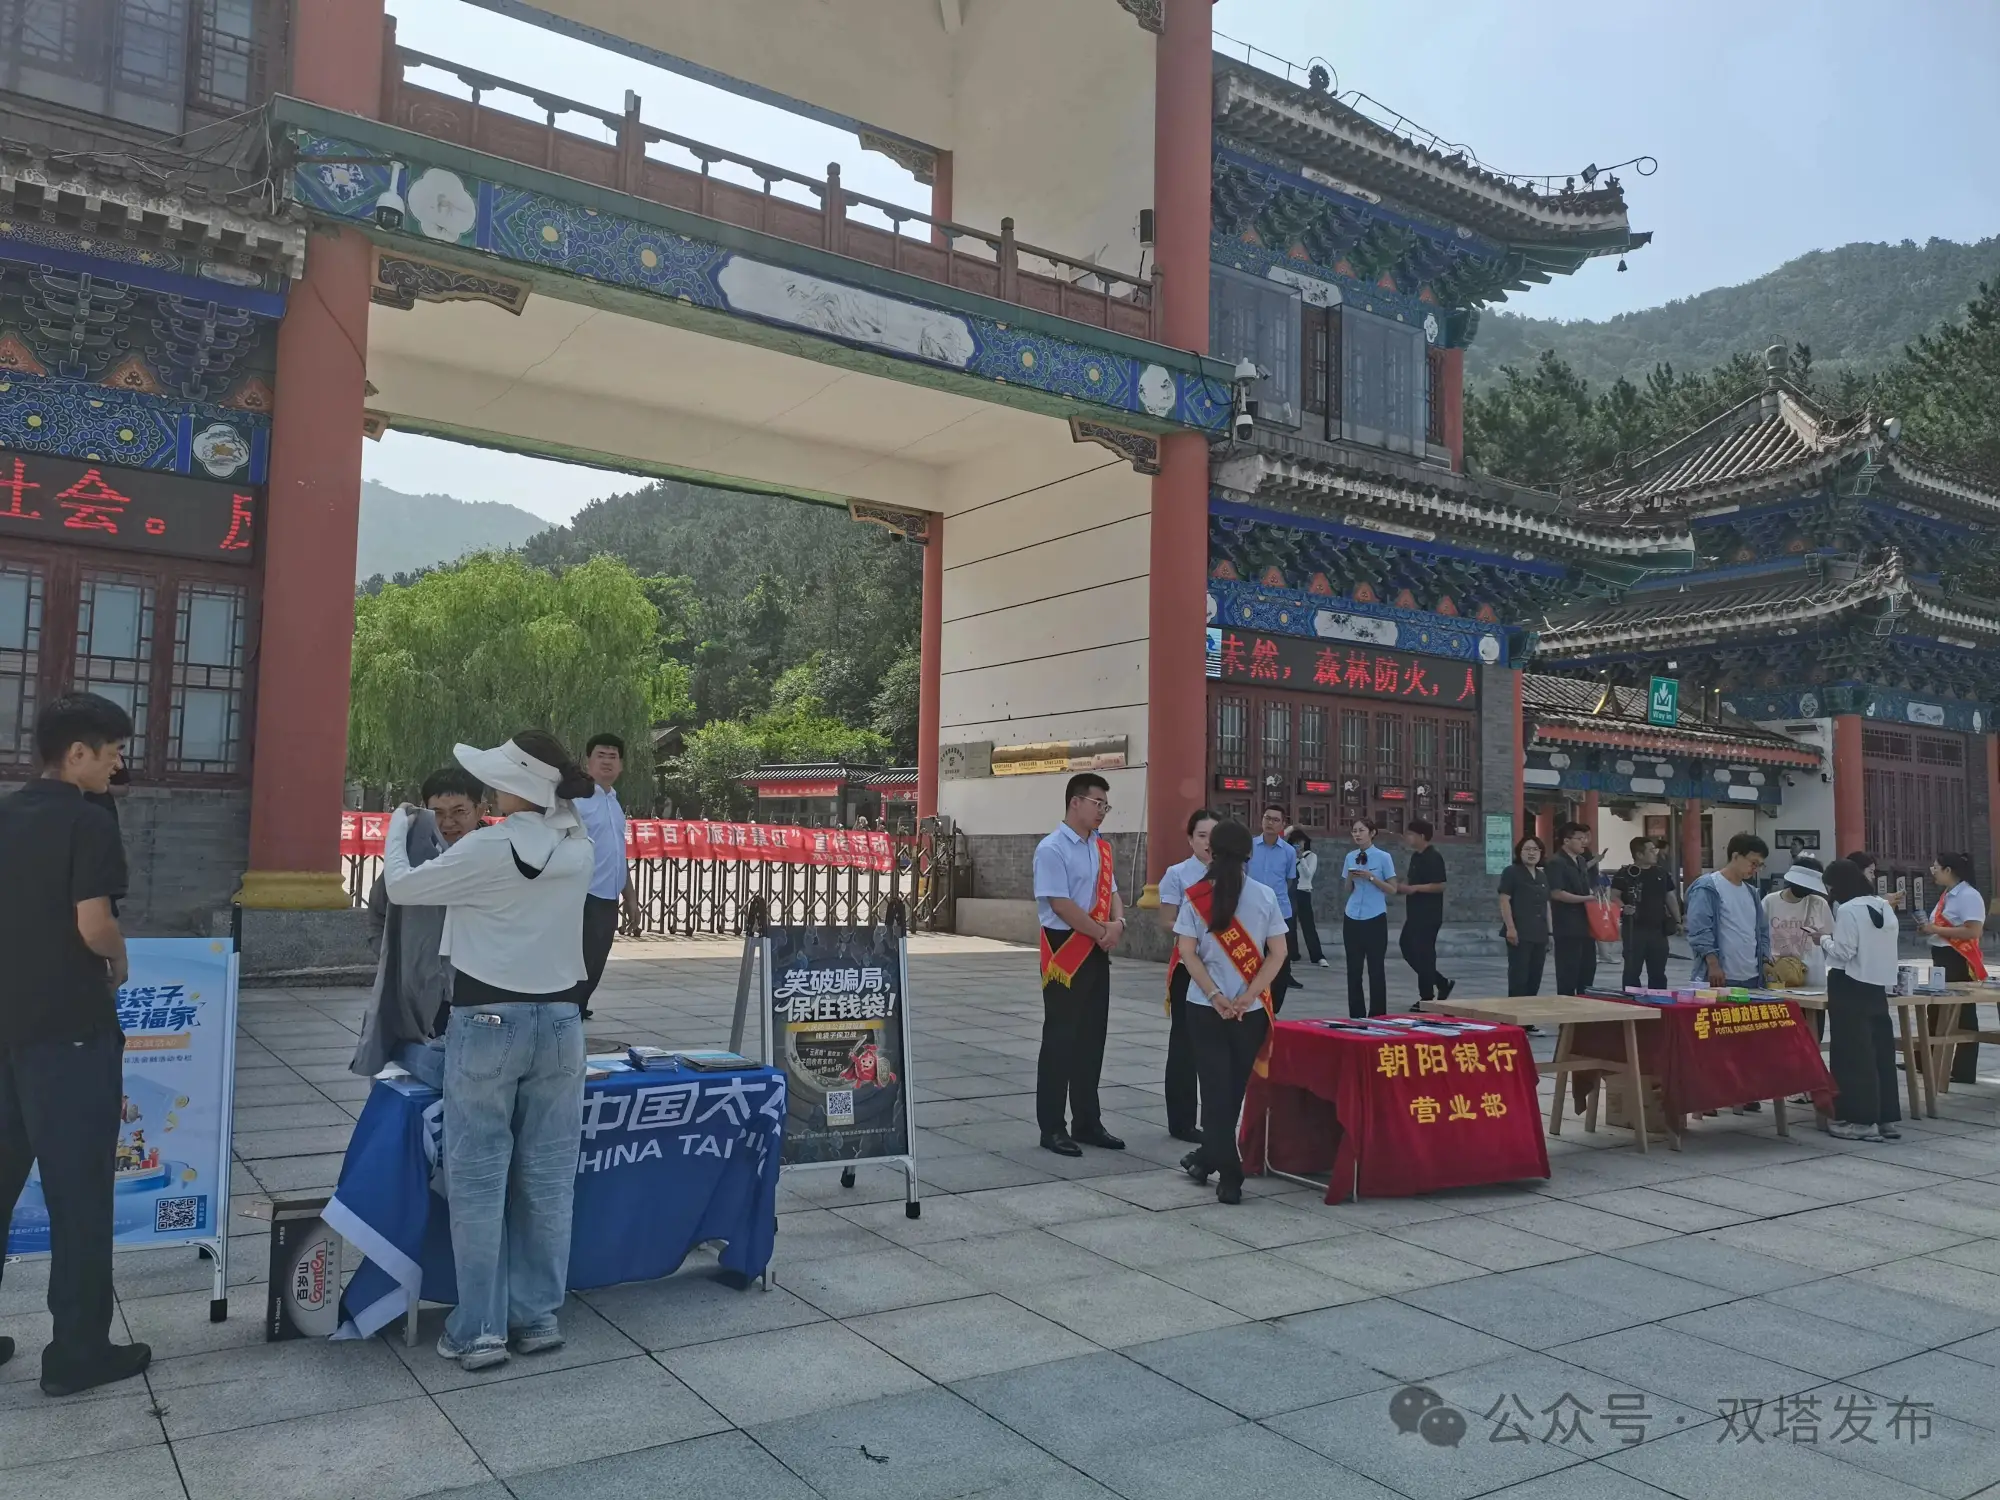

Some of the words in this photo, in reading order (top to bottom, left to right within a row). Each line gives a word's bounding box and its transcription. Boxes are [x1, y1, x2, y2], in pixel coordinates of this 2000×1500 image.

[1711, 1004, 1790, 1025] 中国邮政储蓄银行
[1715, 1026, 1734, 1035] POSTAL
[1377, 1043, 1518, 1078] 朝阳银行
[1409, 1092, 1507, 1124] 营业部
[578, 1139, 662, 1173] HINA
[297, 1262, 309, 1300] 百岁山
[309, 1250, 325, 1303] Ganten
